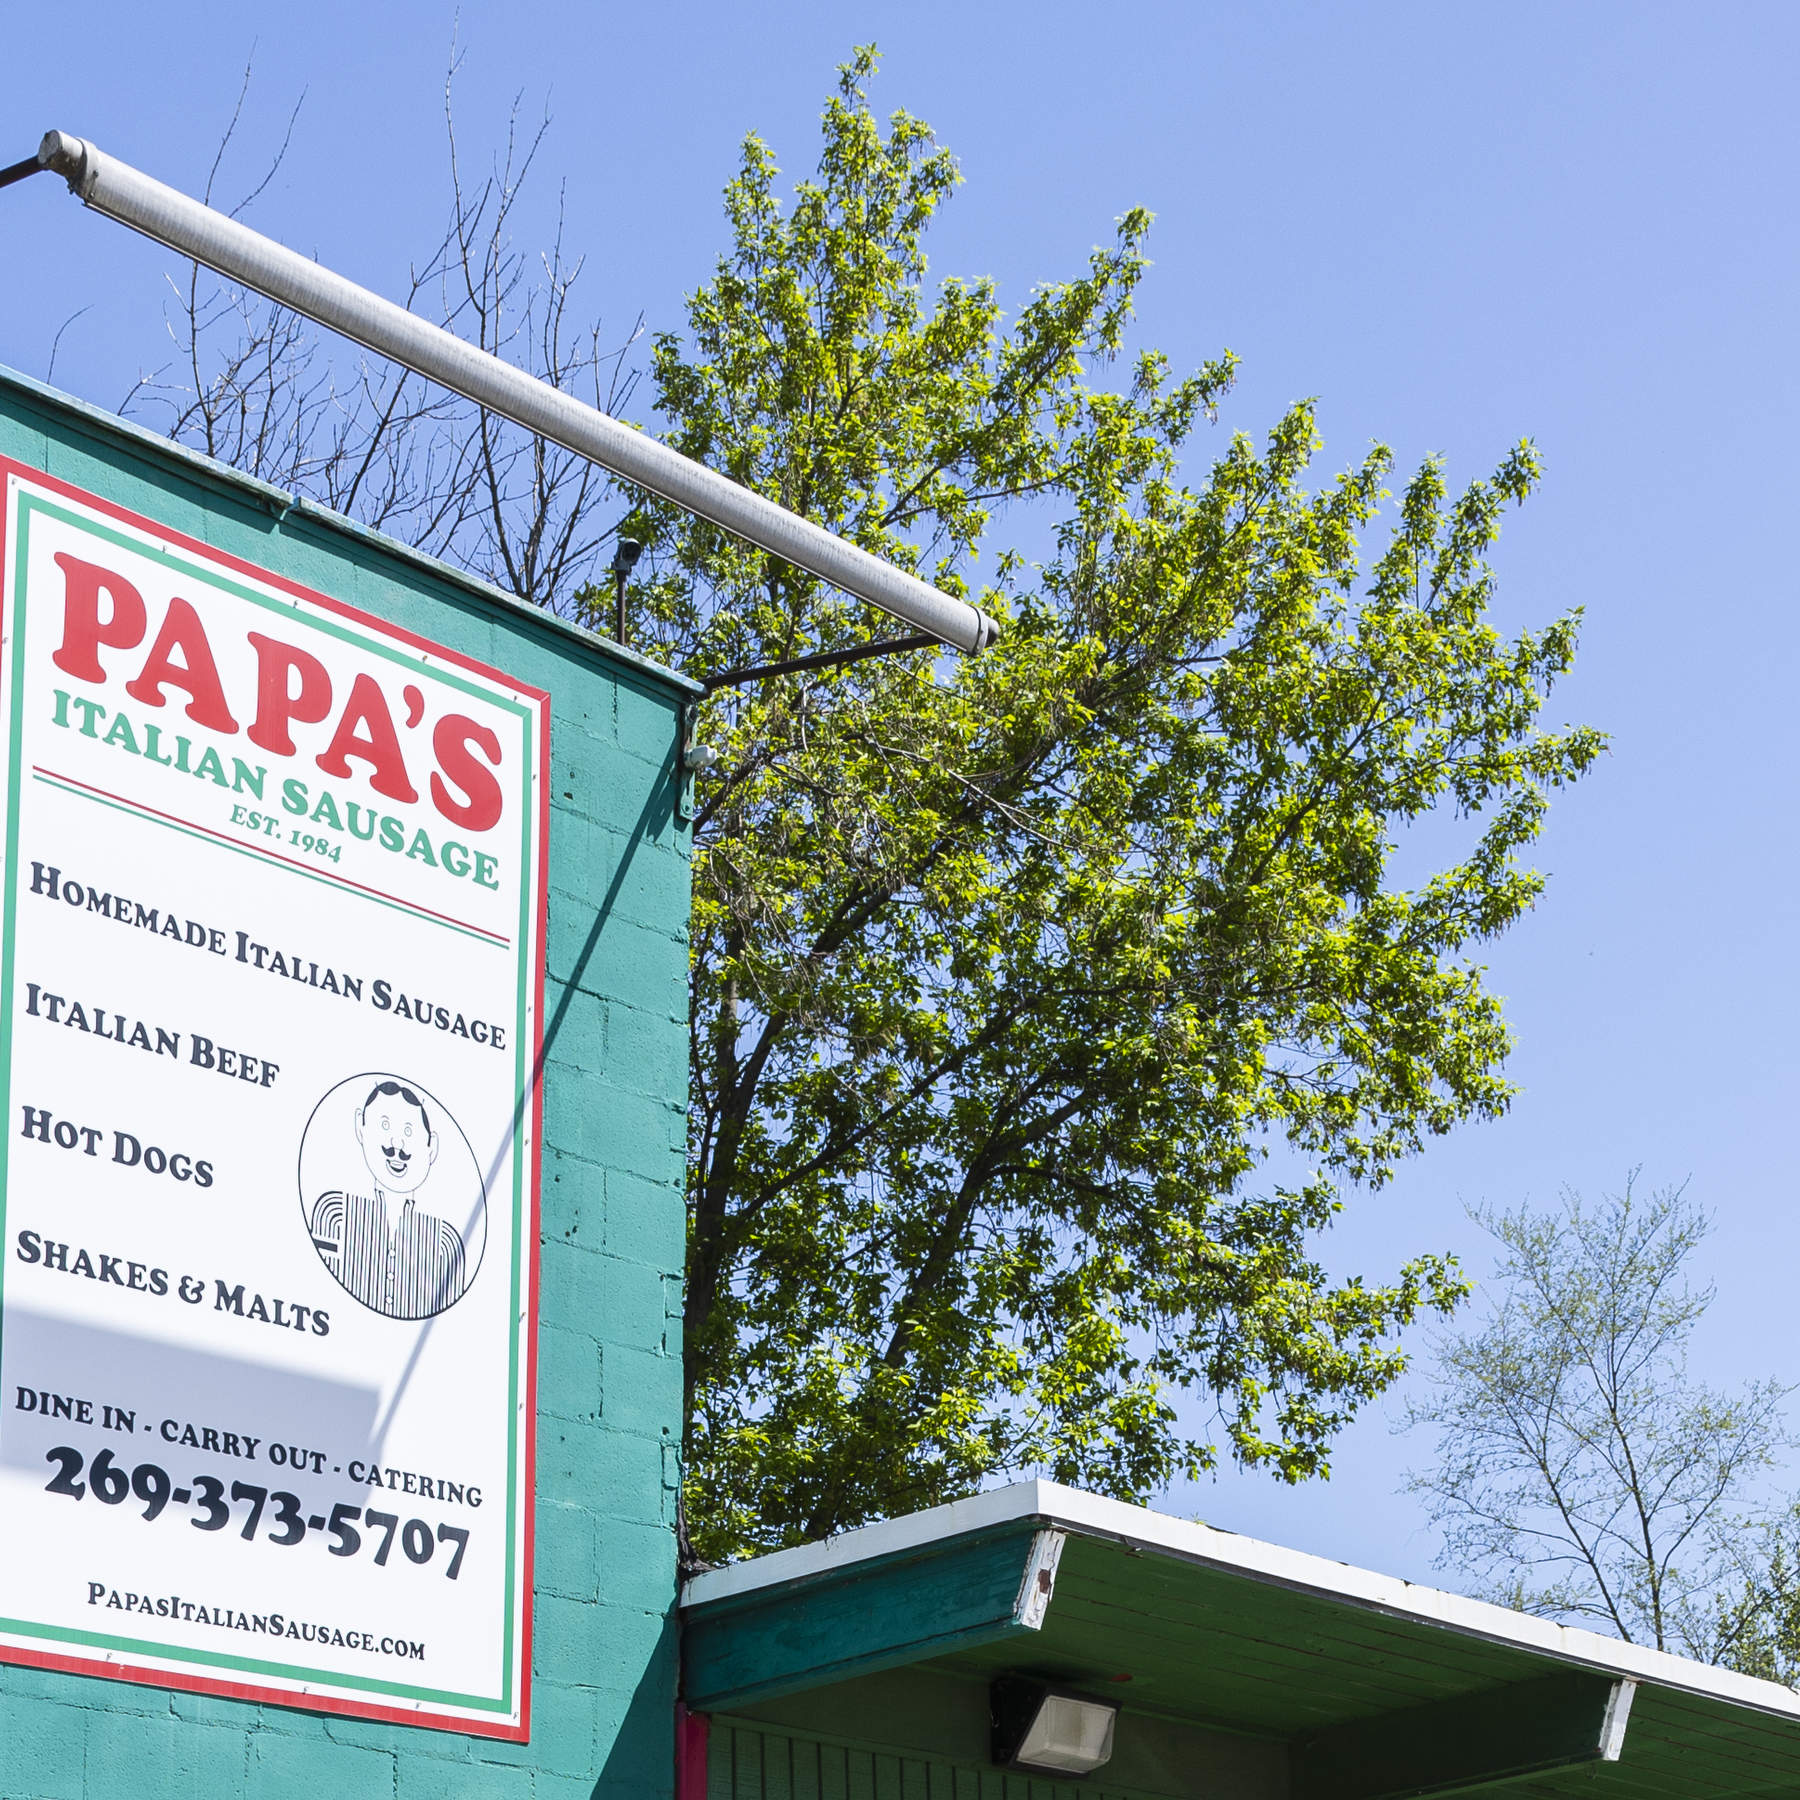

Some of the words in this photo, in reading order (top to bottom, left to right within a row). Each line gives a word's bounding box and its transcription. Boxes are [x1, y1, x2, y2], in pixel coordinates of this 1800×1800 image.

[52, 552, 502, 832] PAPA'S
[52, 690, 267, 800] ITALIAN
[282, 779, 498, 890] SAUSAGE
[230, 805, 280, 838] EST.
[290, 831, 341, 863] 1984
[179, 1276, 204, 1303] &
[16, 1386, 93, 1424] DINE
[102, 1406, 136, 1433] IN
[161, 1419, 261, 1459] CARRY
[269, 1443, 326, 1474] OUT
[348, 1461, 482, 1507] CATERING
[45, 1446, 469, 1579] 269-373-5707
